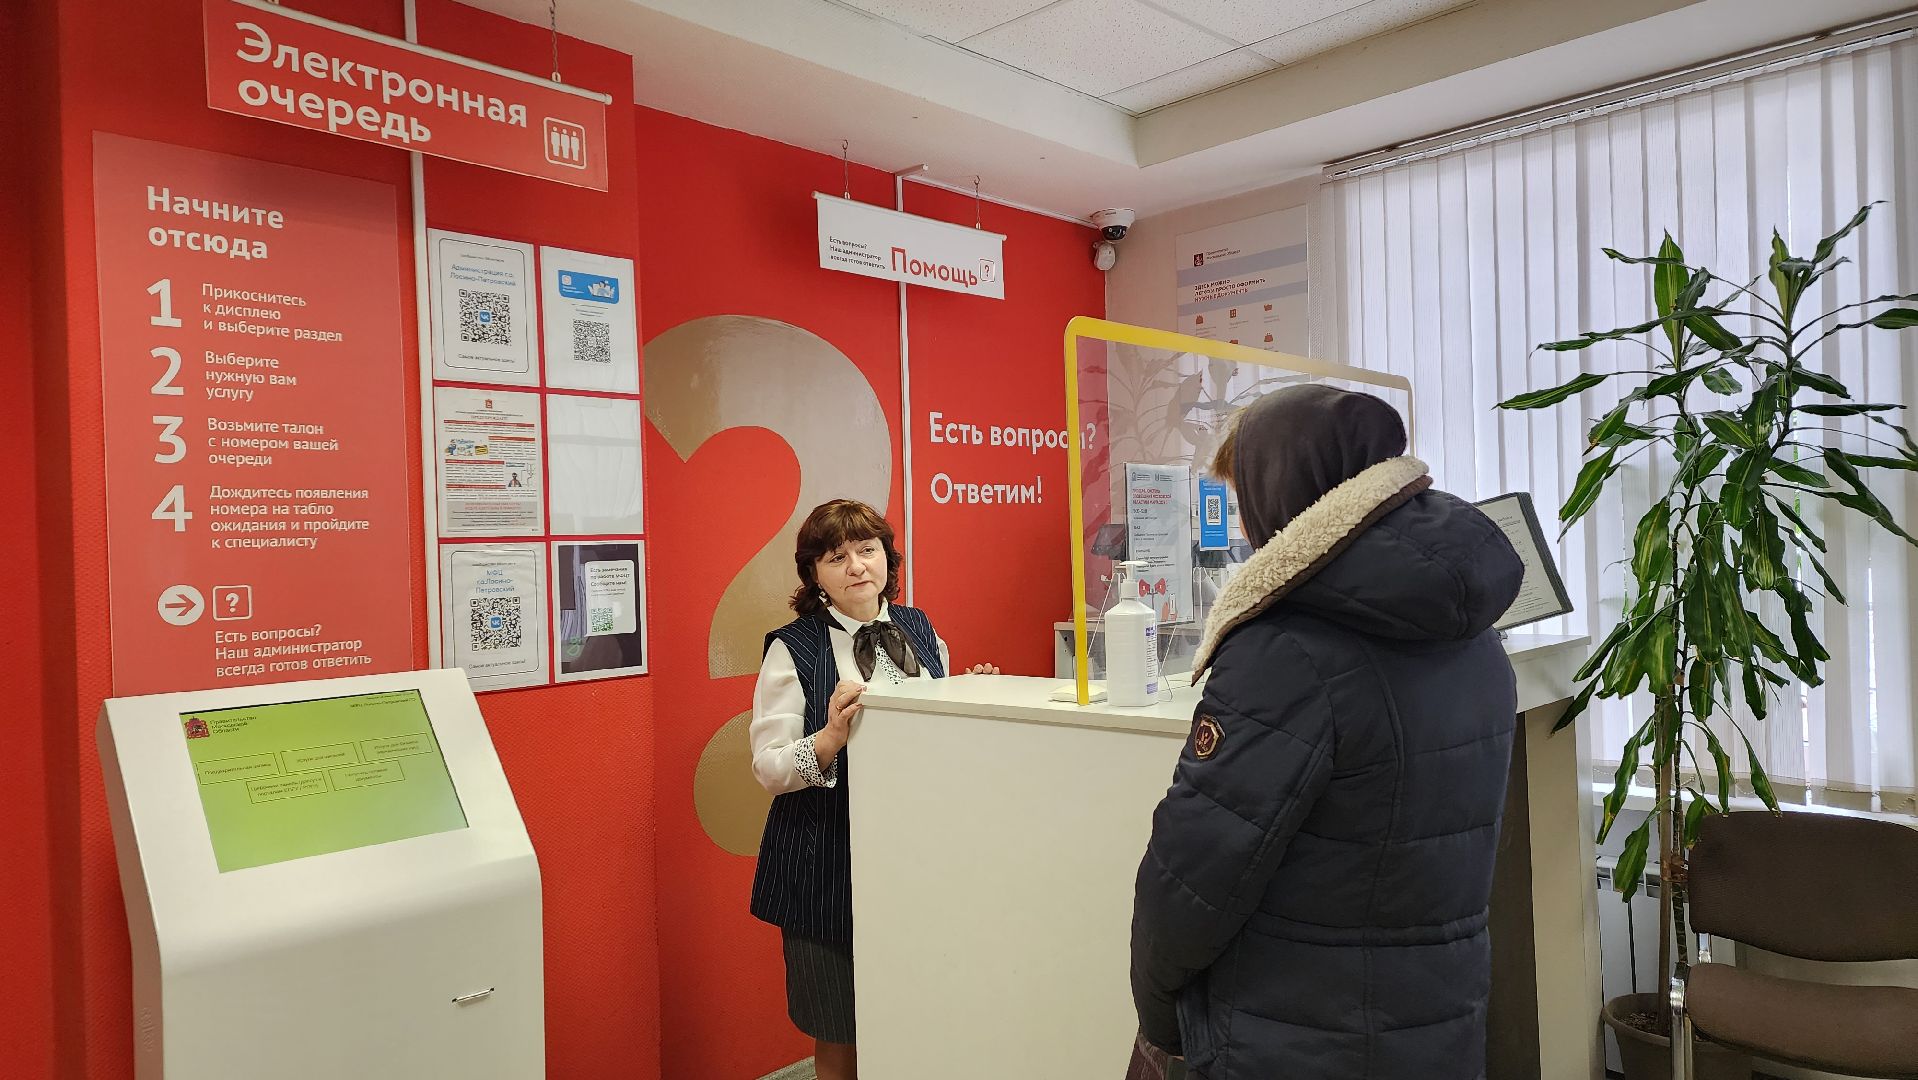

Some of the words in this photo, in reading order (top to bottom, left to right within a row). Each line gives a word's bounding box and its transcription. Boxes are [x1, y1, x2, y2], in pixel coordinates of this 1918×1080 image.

[234, 20, 528, 128] Электронная
[237, 76, 432, 145] очередь
[146, 185, 285, 230] Начните
[148, 225, 269, 262] отсюда
[829, 244, 842, 253] Наш
[843, 249, 882, 261] администратор
[891, 246, 978, 289] Помощь
[145, 278, 182, 328] 1
[201, 283, 307, 308] Прикоснитесь
[203, 302, 212, 313] к
[215, 303, 281, 321] дисплею
[203, 319, 213, 330] и
[218, 320, 290, 338] выберите
[294, 328, 344, 342] раздел
[205, 350, 279, 369] Выберите
[150, 346, 184, 396] 2
[205, 369, 265, 386] нужную
[269, 373, 297, 386] вам
[205, 386, 254, 402] услугу
[207, 418, 279, 434] Возьмите
[281, 422, 324, 435] талон
[929, 411, 984, 445] Есть
[152, 415, 187, 464] 3
[208, 436, 217, 447] с
[221, 436, 290, 452] номером
[293, 439, 339, 452] вашей
[208, 452, 272, 468] очереди
[210, 485, 292, 501] Дождитесь
[295, 488, 369, 500] появления
[930, 472, 1043, 505] Ответим!
[151, 484, 193, 532] 4
[210, 503, 267, 517] номера
[272, 504, 290, 515] на
[293, 502, 334, 516] табло
[210, 520, 286, 533] ожидания
[291, 520, 300, 531] и
[304, 518, 369, 533] пройдите
[211, 538, 221, 549] к
[225, 535, 318, 551] специалисту
[215, 630, 247, 644] Есть
[251, 624, 322, 643] вопросы?
[215, 646, 249, 660] Наш
[253, 639, 363, 660] администратор
[216, 664, 265, 678] всегда
[269, 661, 308, 673] готов
[312, 654, 373, 669] ответить
